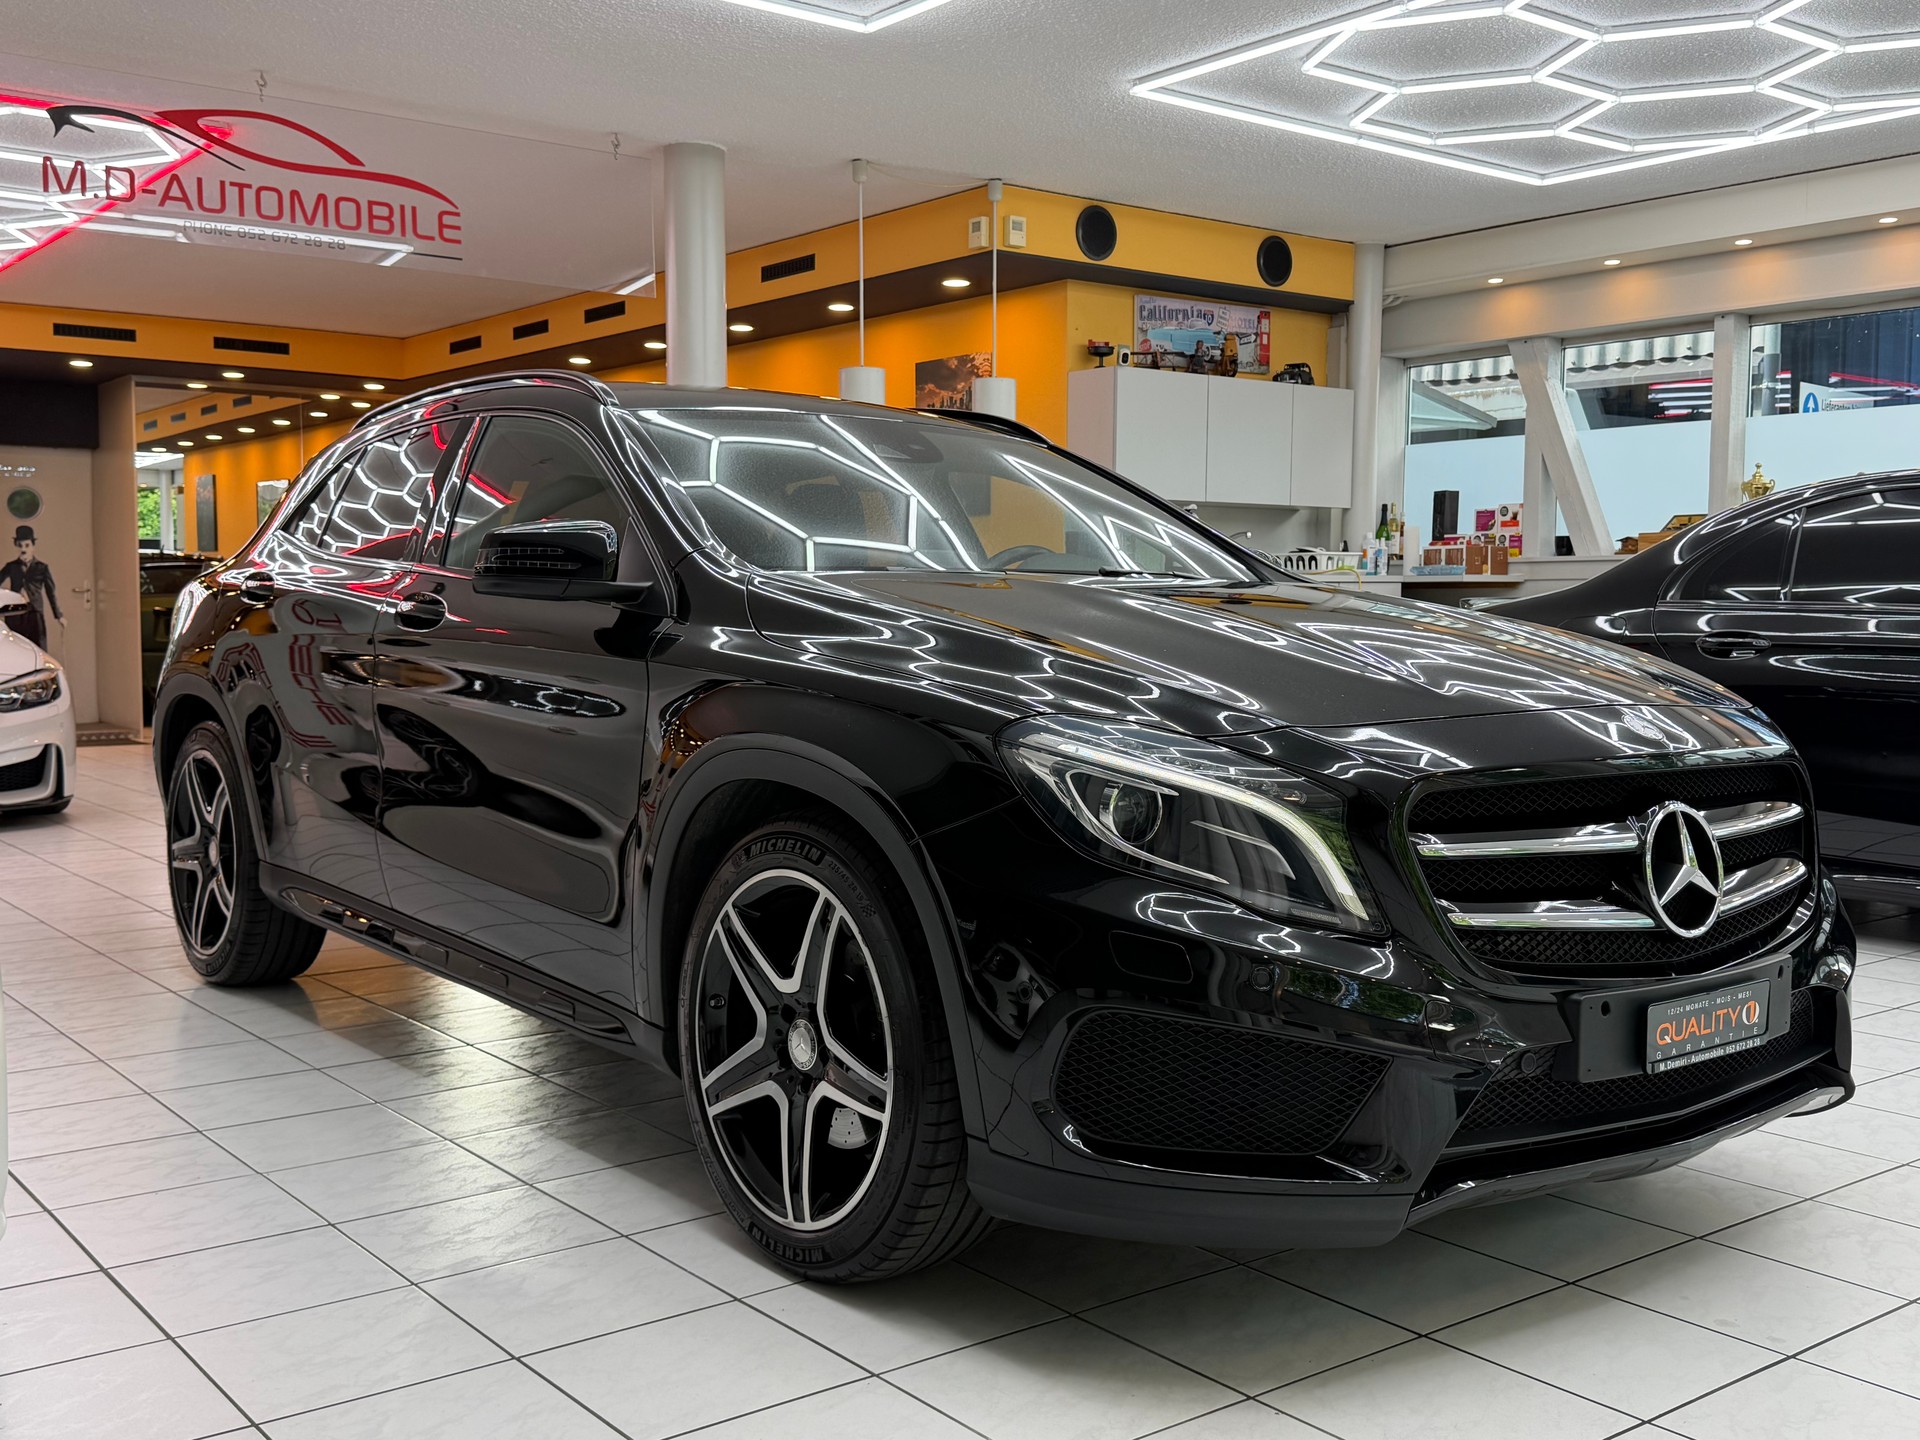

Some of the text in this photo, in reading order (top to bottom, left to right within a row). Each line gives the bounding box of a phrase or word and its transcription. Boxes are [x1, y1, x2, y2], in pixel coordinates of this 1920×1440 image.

[183, 219, 346, 251] PHONE 052 672 28 28
[1139, 304, 1202, 322] California
[749, 838, 821, 862] MICHELIN
[1667, 1006, 1683, 1015] 12/24
[1685, 1000, 1709, 1011] MONATE
[1716, 995, 1731, 1004] MOIS
[1738, 990, 1752, 999] MESI
[1656, 1005, 1741, 1046] QUALITY
[1656, 1026, 1758, 1060] GARANTIE
[1726, 1044, 1735, 1054] 052
[1736, 1041, 1746, 1051] 672
[1746, 1039, 1753, 1048] 28
[1754, 1037, 1760, 1046] 28
[751, 1228, 824, 1263] MICHELIN
